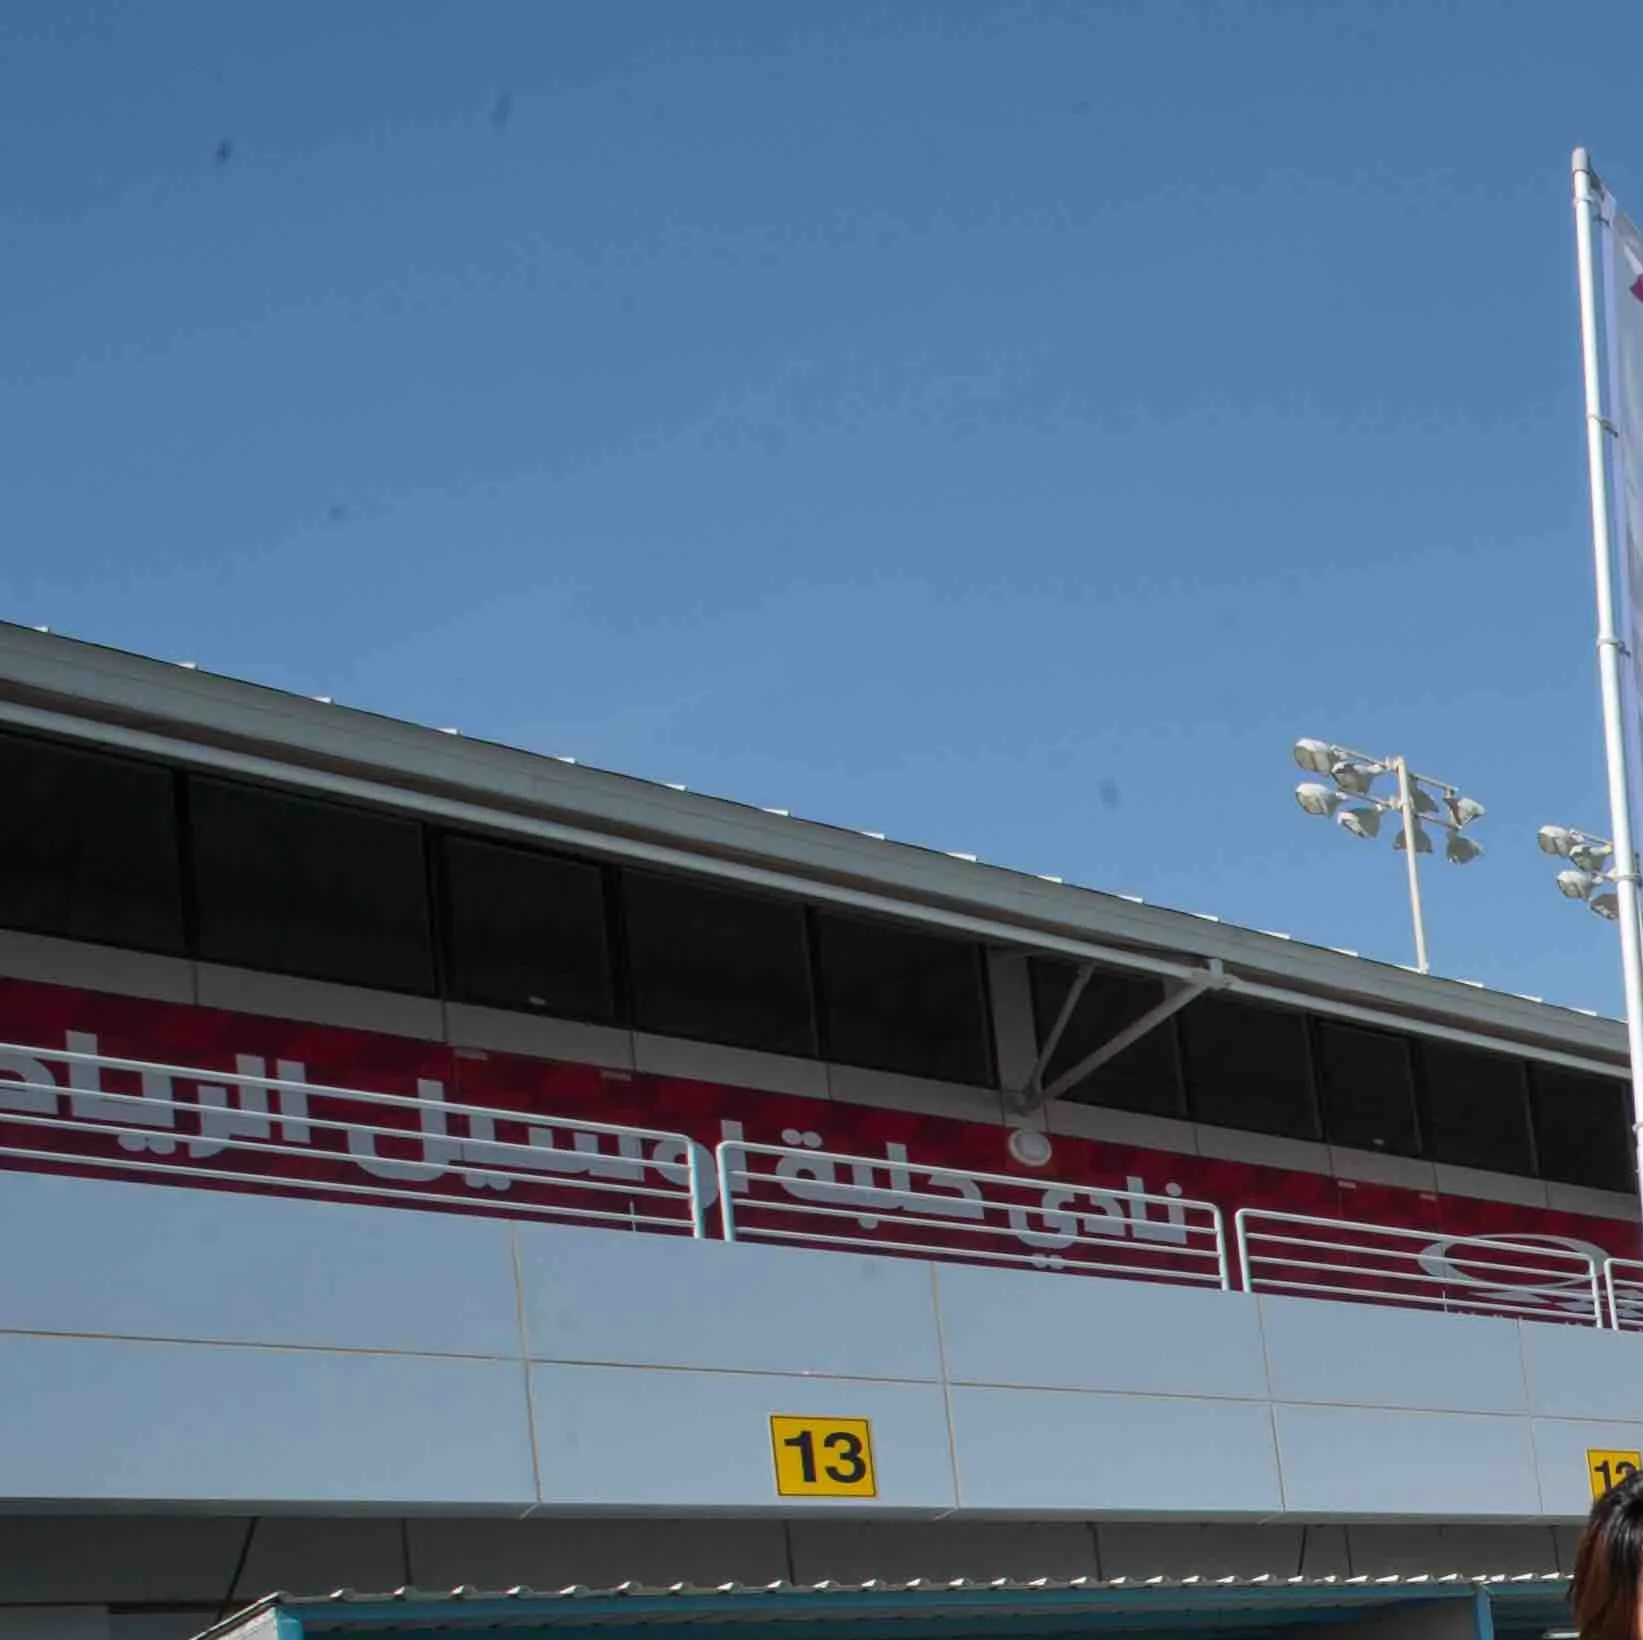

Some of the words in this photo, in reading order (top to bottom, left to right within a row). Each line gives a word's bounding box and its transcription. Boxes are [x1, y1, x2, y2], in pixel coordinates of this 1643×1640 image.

[775, 1128, 985, 1230] حلبة
[1008, 1175, 1188, 1271] نادي
[783, 1430, 867, 1484] 13
